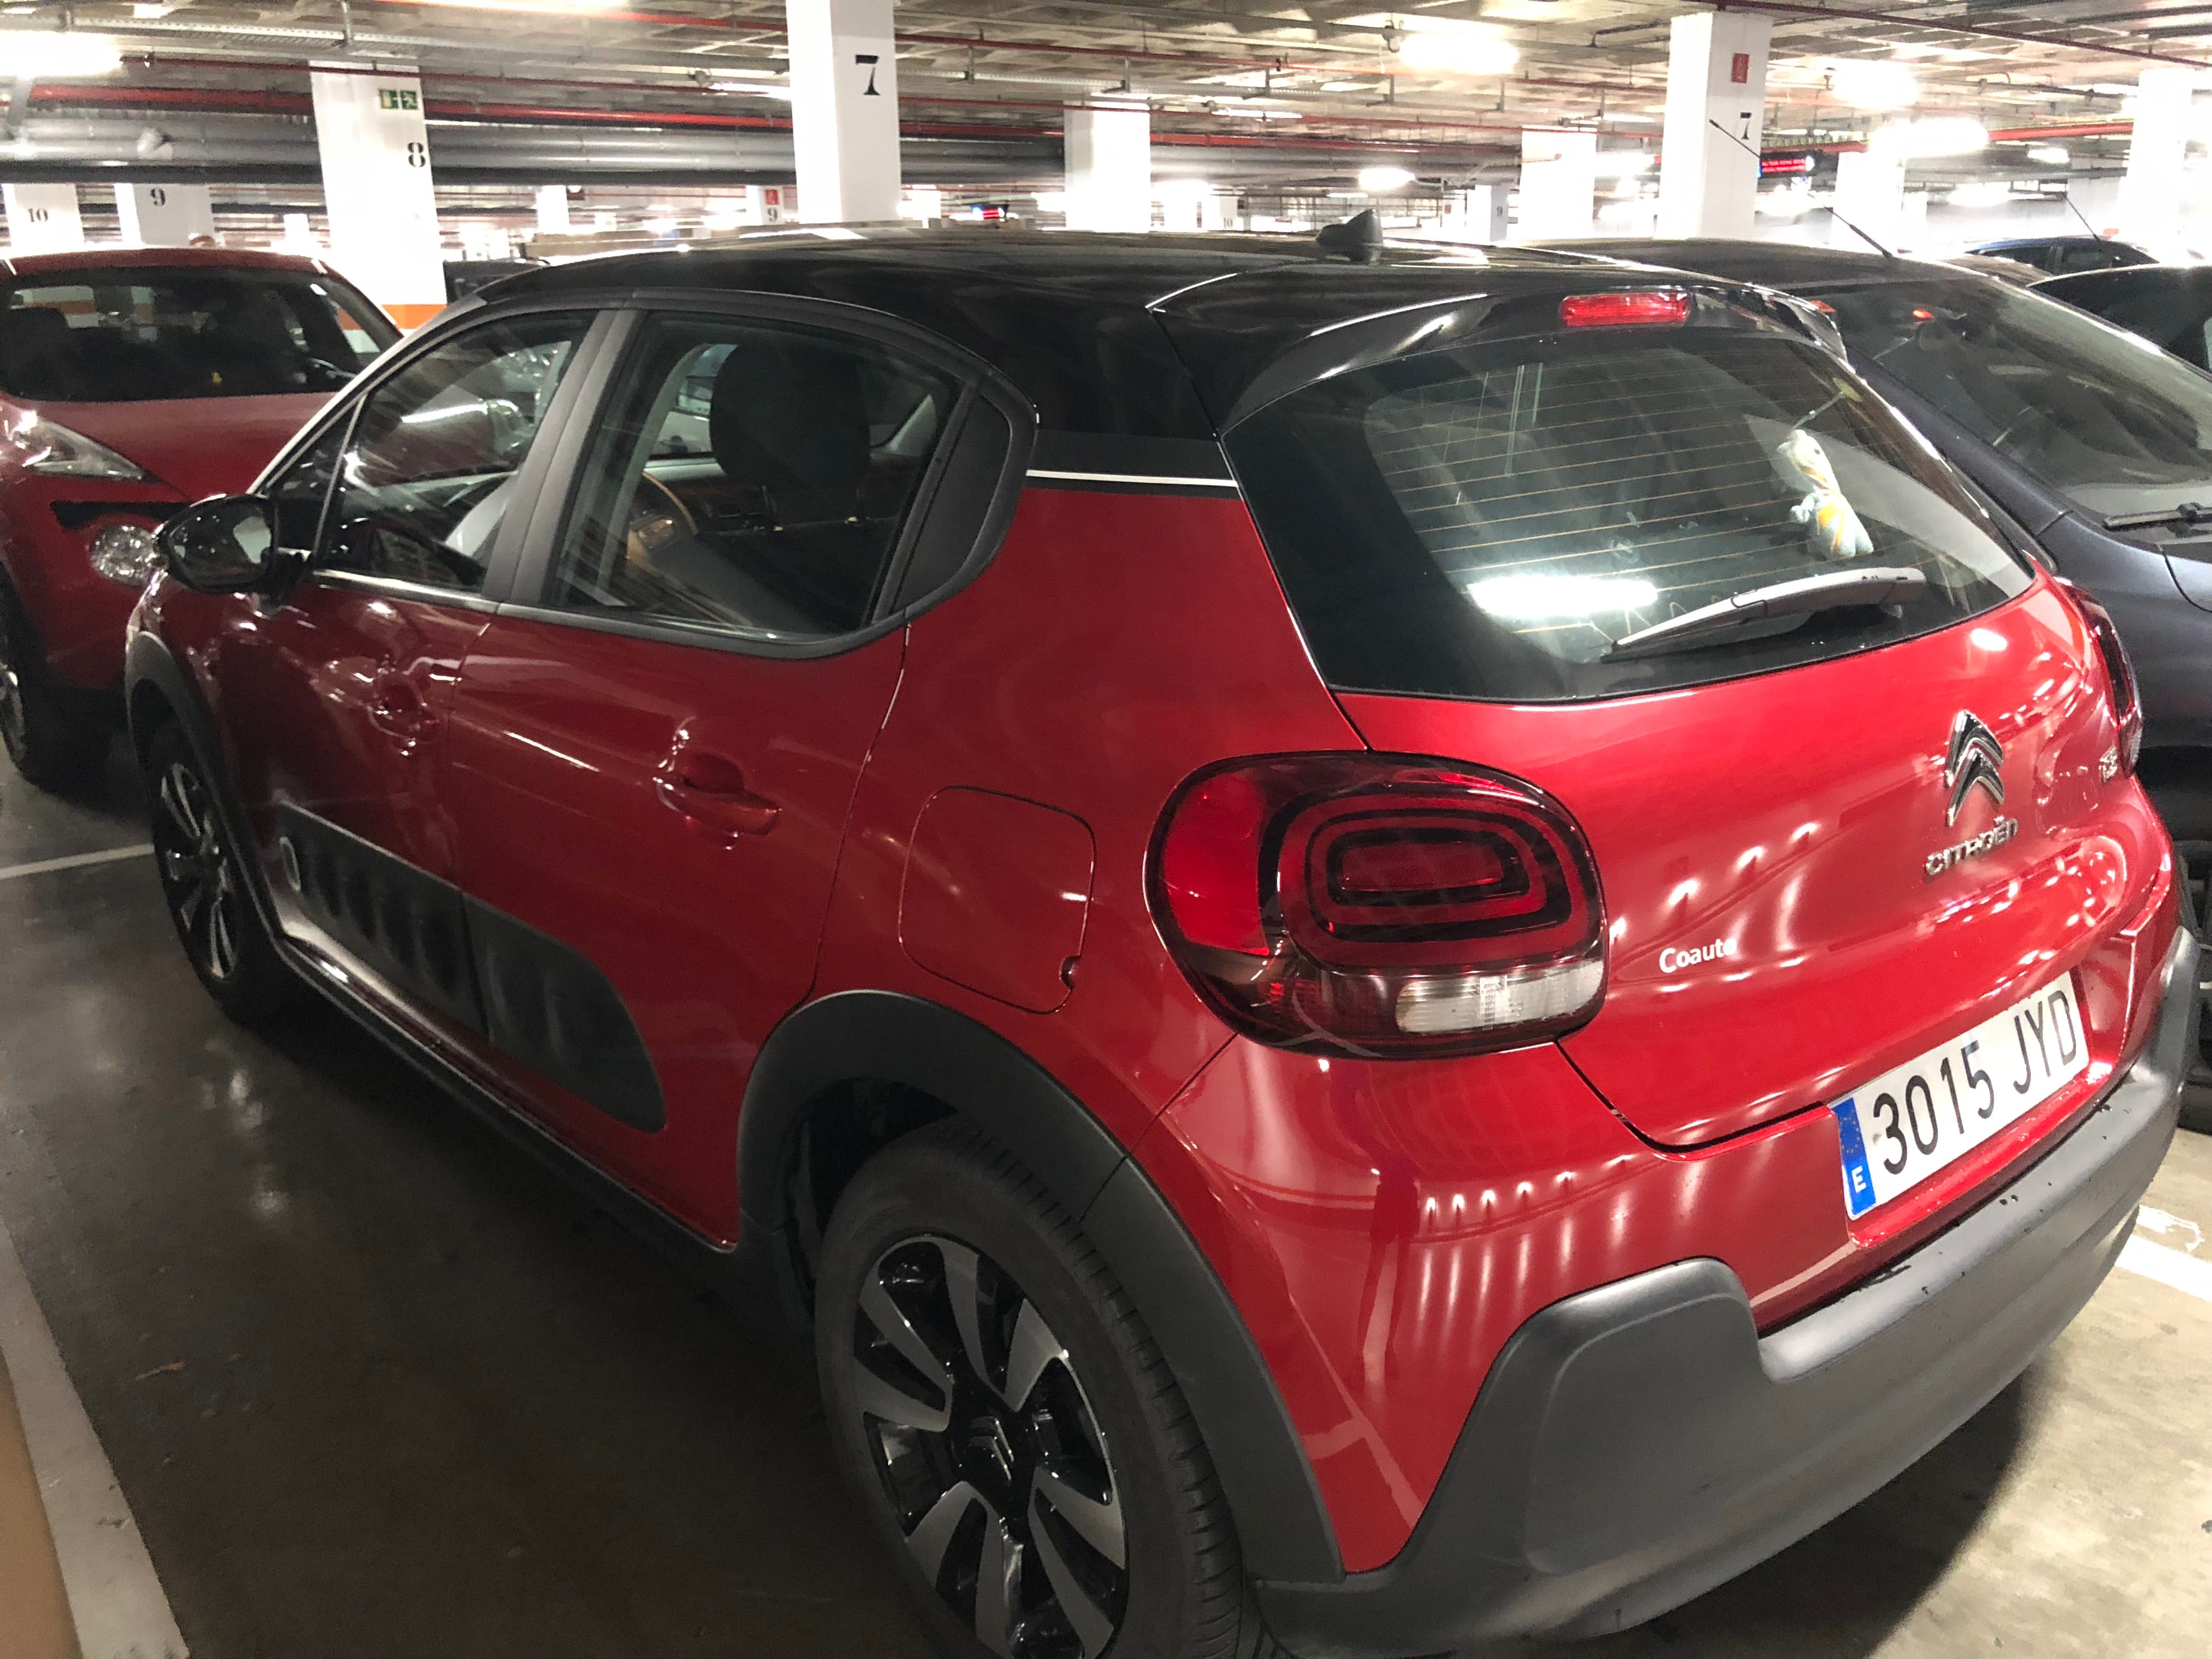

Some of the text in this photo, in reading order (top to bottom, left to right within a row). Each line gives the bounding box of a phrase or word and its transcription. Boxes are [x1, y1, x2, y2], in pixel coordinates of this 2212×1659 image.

[855, 54, 881, 95] 7
[1740, 112, 1752, 140] 7
[408, 142, 426, 168] 8
[150, 188, 166, 207] 9
[27, 208, 49, 222] 10
[767, 208, 778, 222] 9
[1659, 938, 1737, 973] Coauto
[1873, 990, 2077, 1175] 3015 JYD
[1851, 1166, 1866, 1193] E
